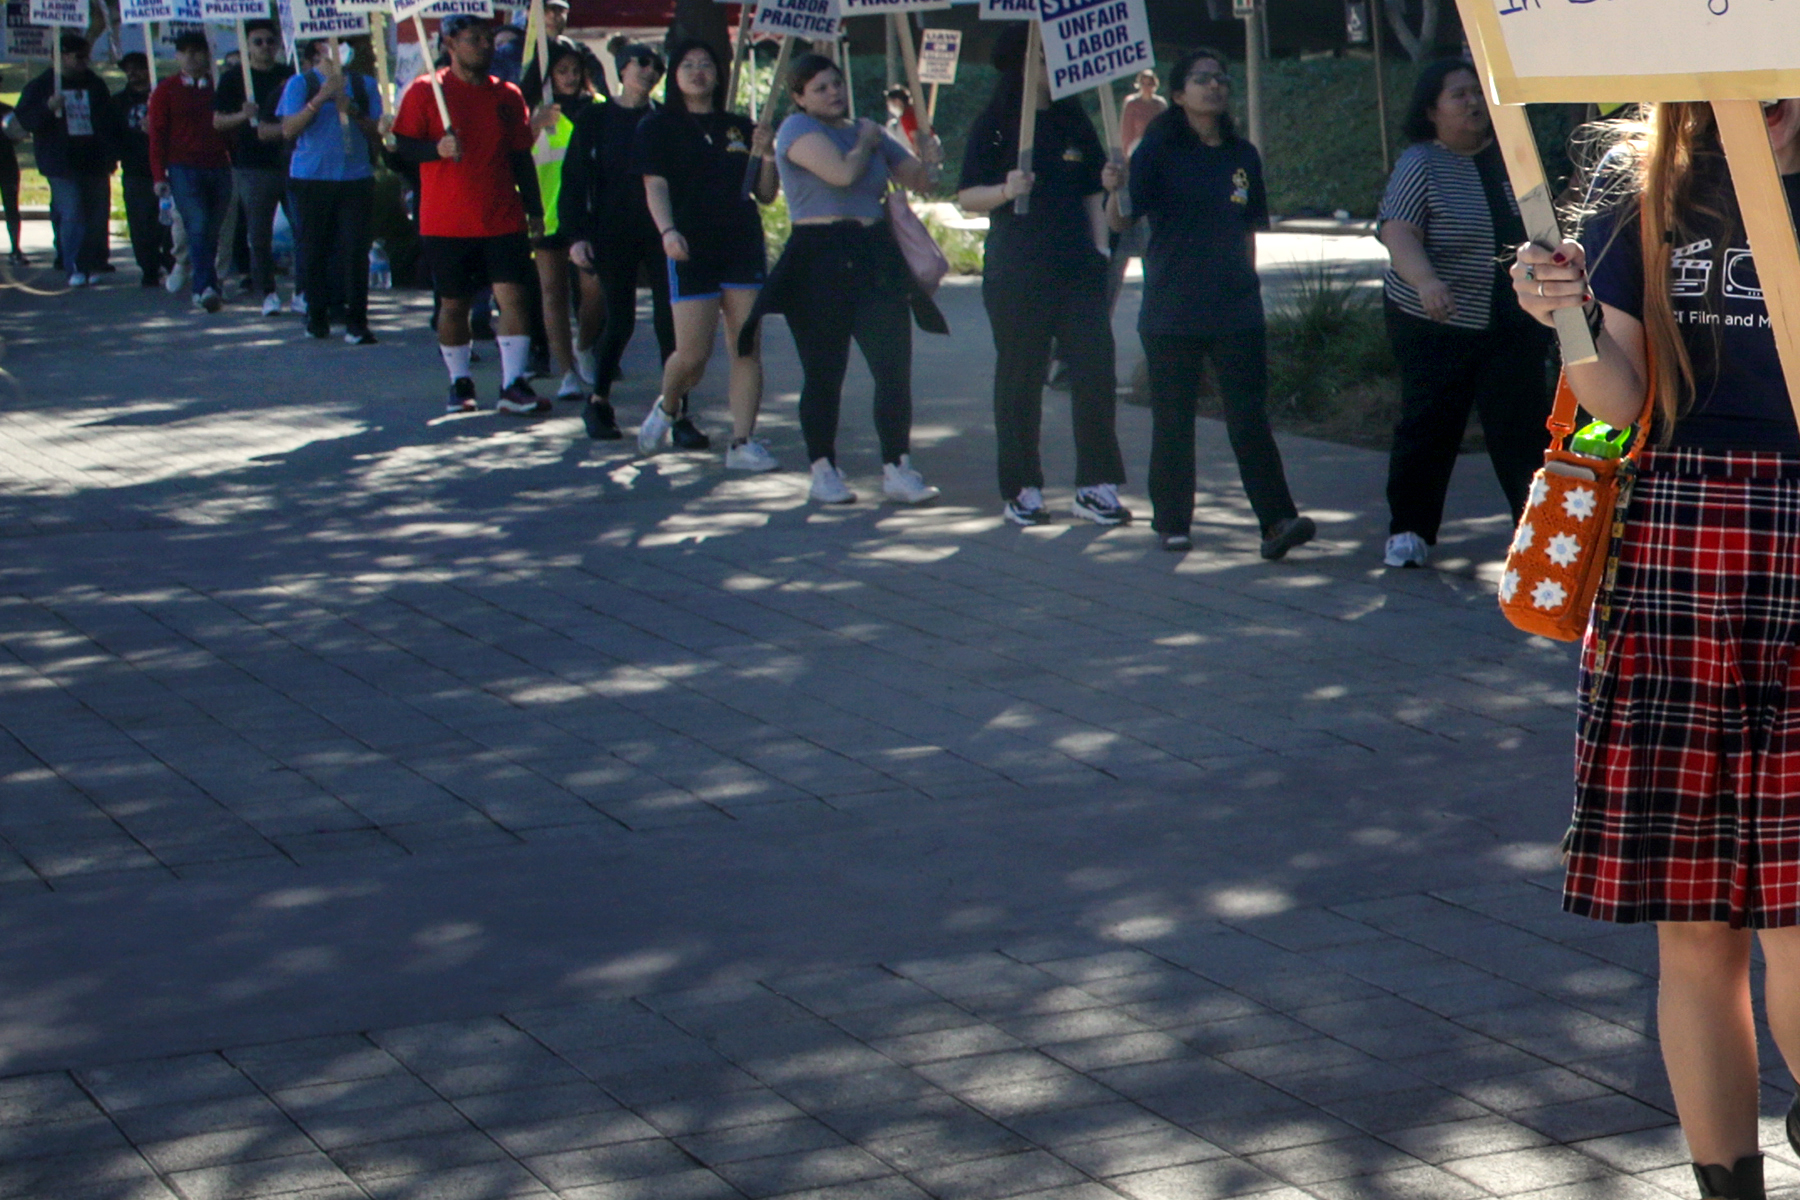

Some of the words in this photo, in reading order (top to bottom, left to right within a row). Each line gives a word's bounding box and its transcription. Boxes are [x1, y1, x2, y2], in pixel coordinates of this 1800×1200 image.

[124, 6, 172, 19] PRACTICE
[205, 2, 265, 13] PRACTICE
[300, 17, 364, 33] PRACTICE
[760, 8, 836, 33] PRACTICE
[1058, 2, 1129, 40] UNFAIR
[1066, 24, 1129, 61] LABOR
[1055, 41, 1148, 88] PRACTICE
[1690, 310, 1720, 325] Film
[1725, 313, 1754, 327] and
